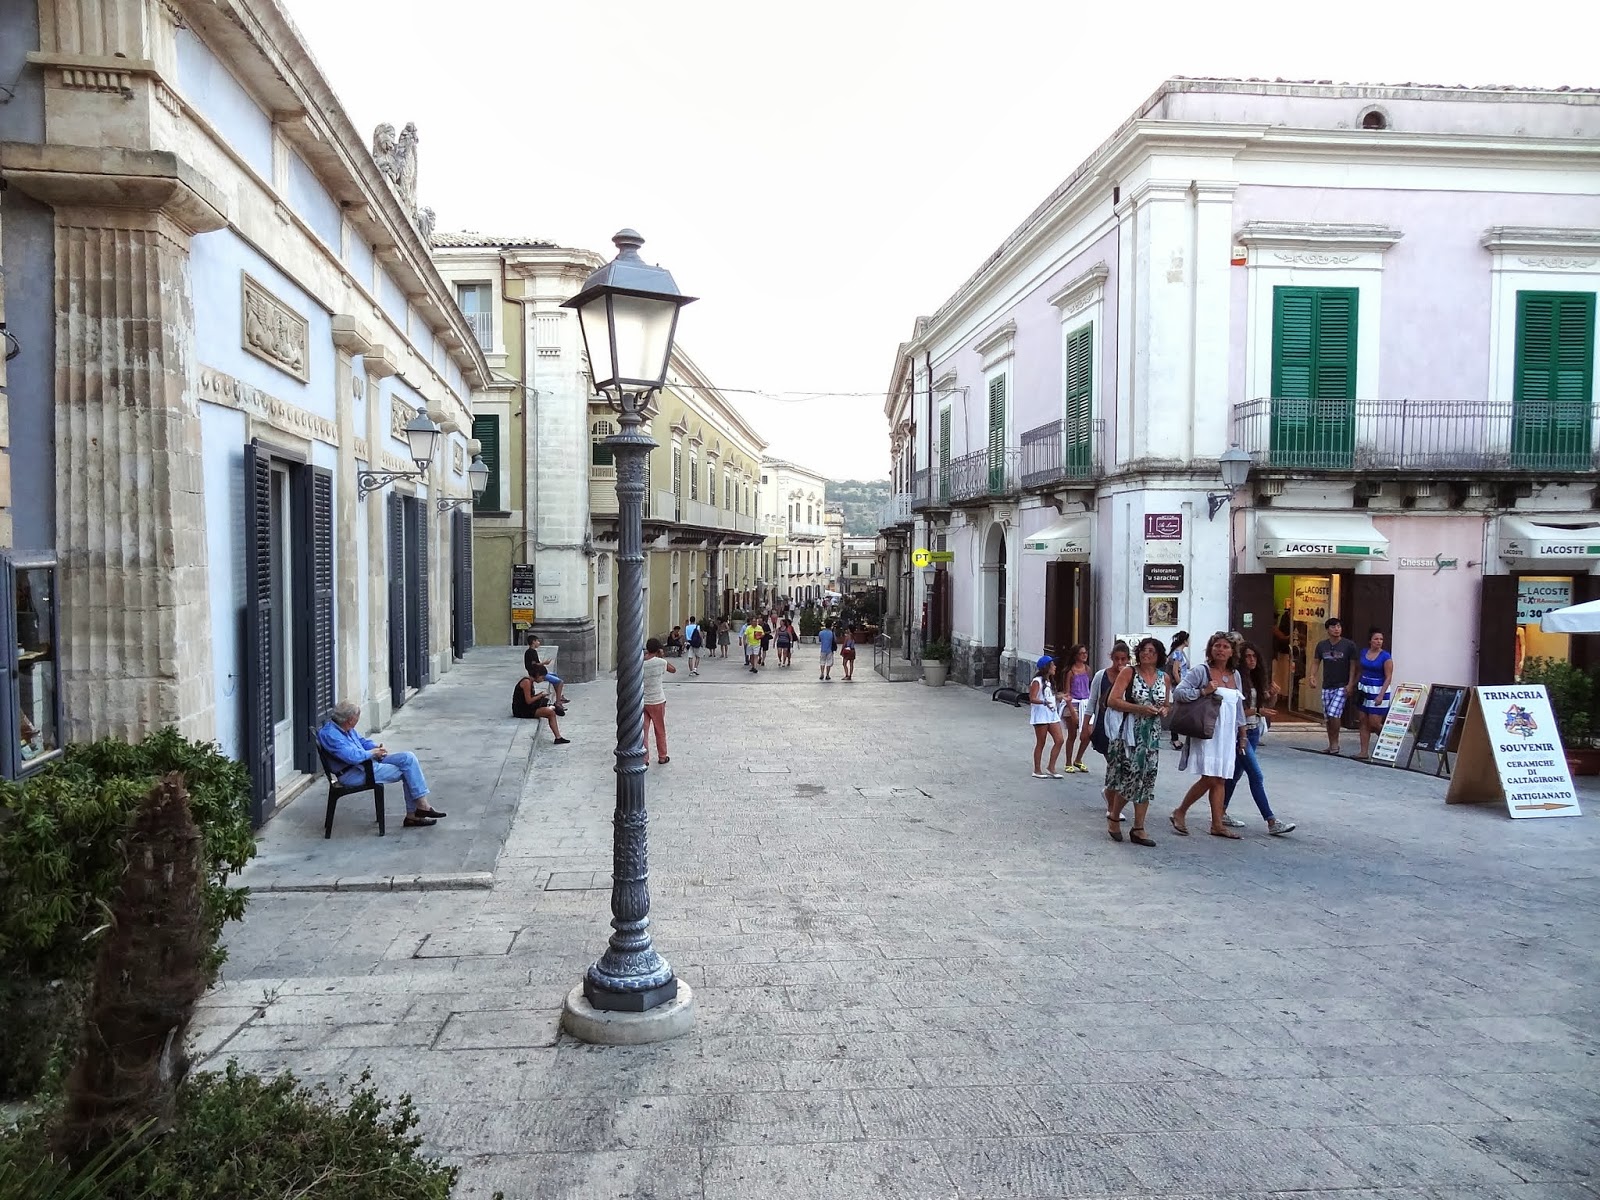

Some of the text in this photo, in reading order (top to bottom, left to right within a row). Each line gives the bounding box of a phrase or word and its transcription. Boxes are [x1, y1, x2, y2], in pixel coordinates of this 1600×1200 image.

[1286, 544, 1334, 553] LACOSTE
[1540, 546, 1585, 554] LACOSTE
[916, 554, 928, 562] PT
[1304, 586, 1330, 596] LACOSTE
[1527, 587, 1569, 596] LACOSTE
[1484, 691, 1544, 700] TRINACRIA
[1500, 743, 1554, 752] SOUVENIR
[1507, 776, 1565, 784] CALTAGIRONE
[1511, 792, 1572, 800] ARTIGIANATO
